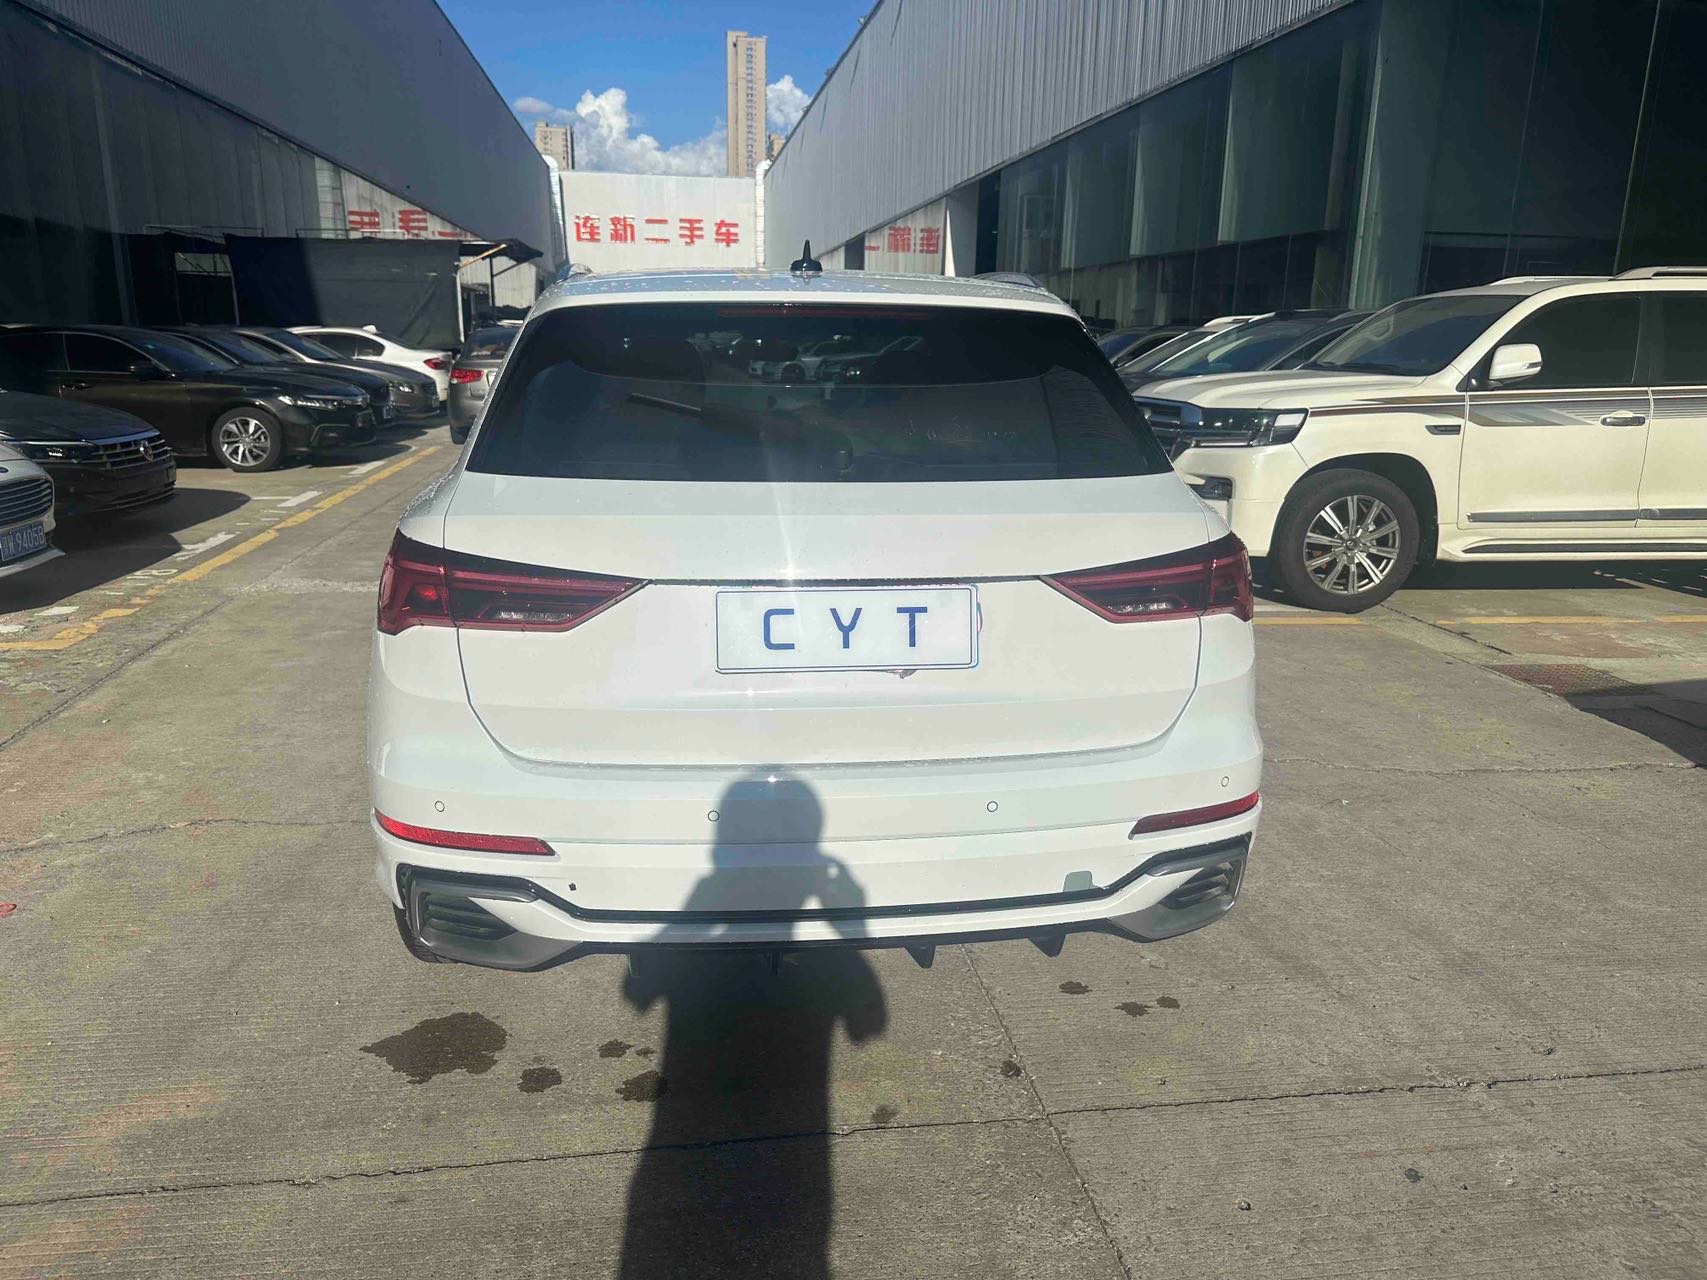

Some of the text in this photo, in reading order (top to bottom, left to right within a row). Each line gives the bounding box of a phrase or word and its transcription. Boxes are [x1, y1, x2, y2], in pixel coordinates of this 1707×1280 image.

[573, 214, 740, 247] 连新二手车
